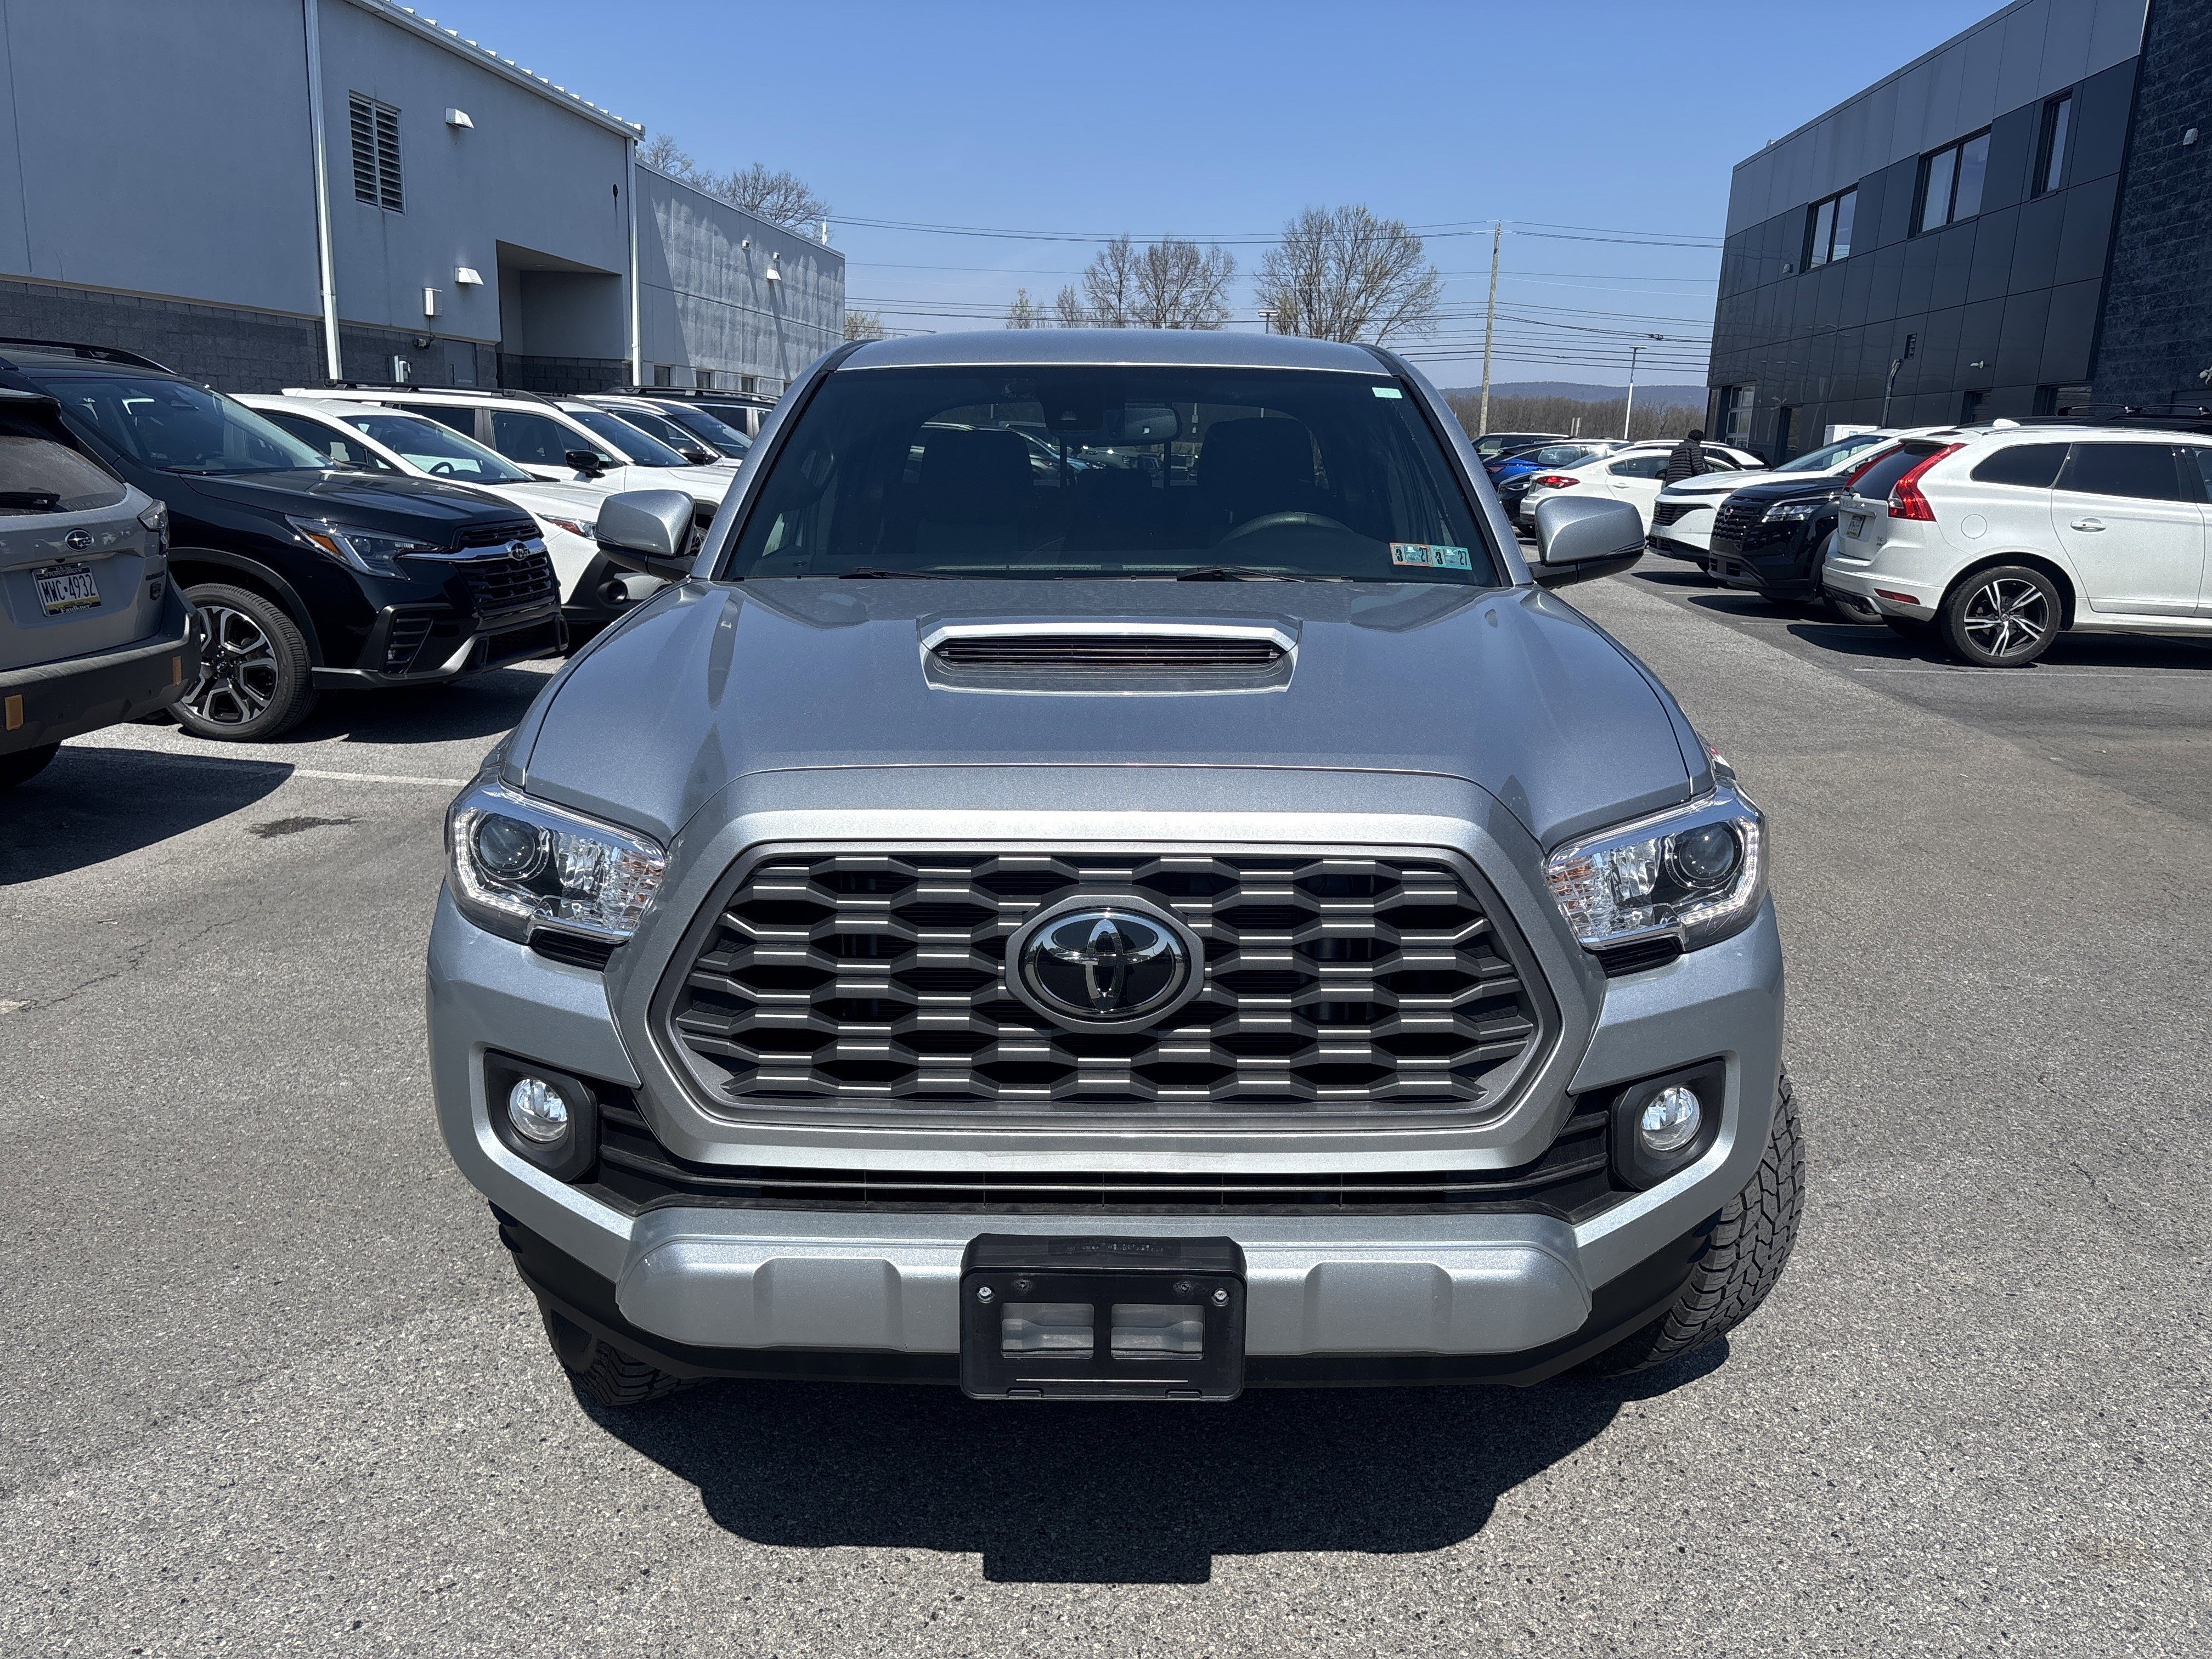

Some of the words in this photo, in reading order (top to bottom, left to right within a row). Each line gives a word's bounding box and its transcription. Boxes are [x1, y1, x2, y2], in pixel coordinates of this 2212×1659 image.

[1396, 549, 1403, 562] 3
[1419, 547, 1429, 563] 27
[1435, 551, 1443, 565] 3
[1457, 550, 1468, 567] 27
